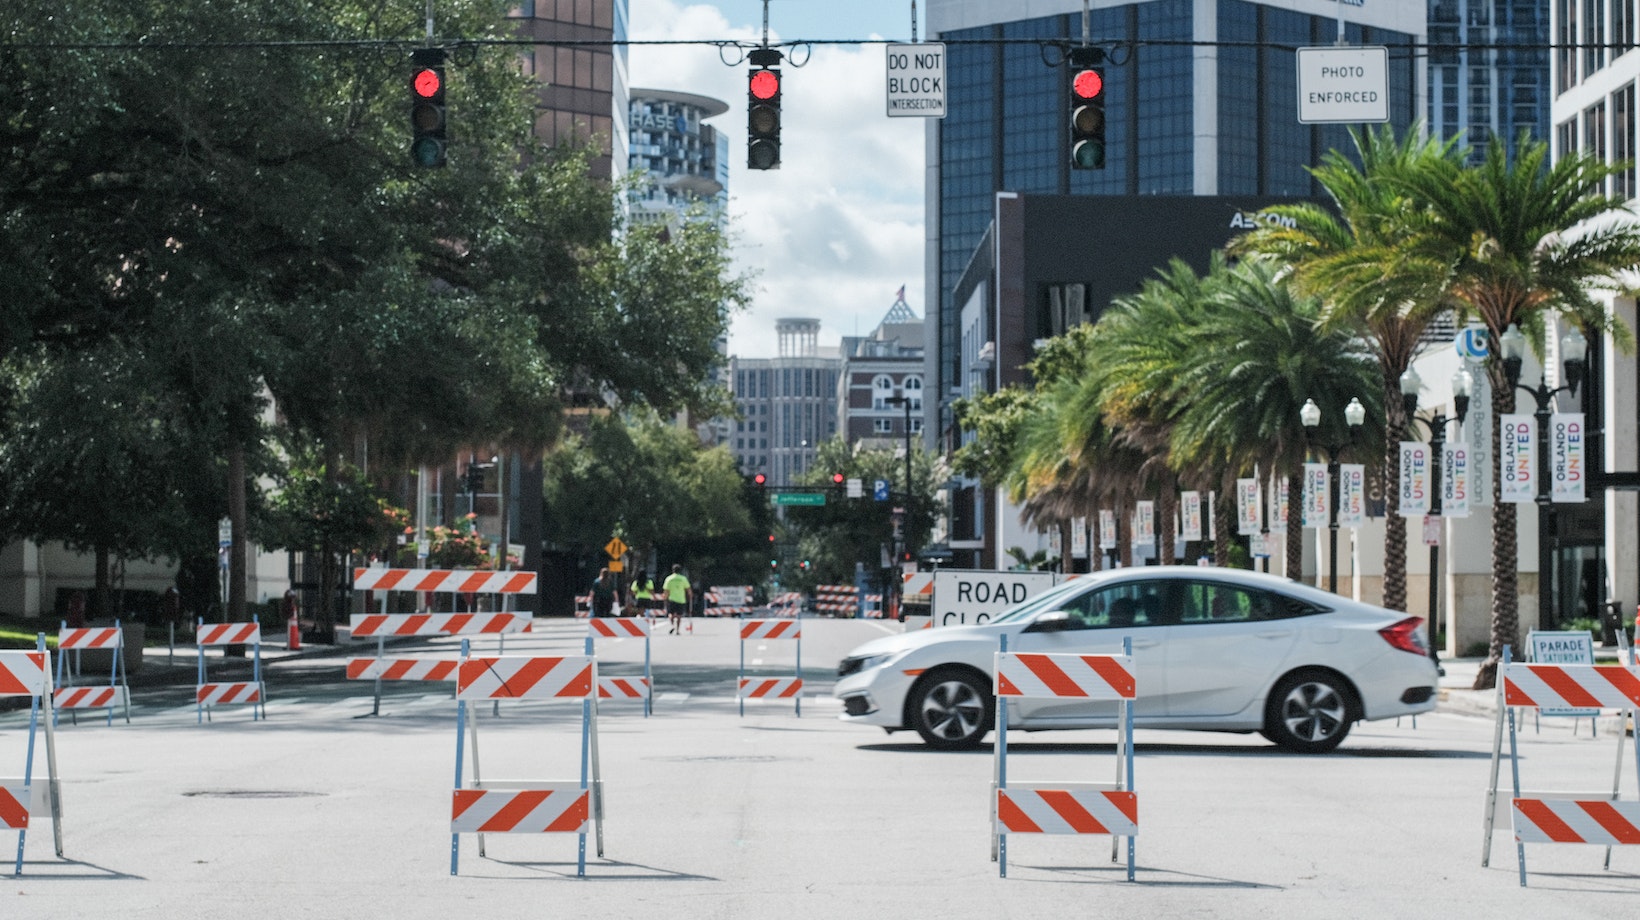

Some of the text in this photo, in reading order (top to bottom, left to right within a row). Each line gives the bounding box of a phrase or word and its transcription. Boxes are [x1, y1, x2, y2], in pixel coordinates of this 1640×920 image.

[889, 53, 942, 70] DO NOT
[1322, 66, 1364, 78] PHOTO
[889, 77, 942, 93] BLOCK
[889, 98, 943, 110] INTERSECTION
[1309, 91, 1378, 104] ENFORCED
[631, 115, 675, 130] HASE
[1505, 423, 1515, 481] ORLANDO
[1517, 423, 1530, 481] UNITED
[1556, 422, 1566, 481] ORLANDO
[1567, 422, 1581, 481] UNITED
[1308, 470, 1316, 512] ORLANDO
[1316, 470, 1326, 513] UNITED
[1351, 471, 1361, 514] UNITED
[1403, 449, 1412, 499] ORLANDO
[1413, 449, 1424, 499] UNITED
[1445, 450, 1454, 500] ORLANDO
[1455, 450, 1466, 500] UNITED
[1473, 452, 1486, 503] Duncan
[958, 581, 1027, 604] ROAD
[1540, 640, 1585, 652] PARADE
[1543, 653, 1585, 663] SATURDAY
